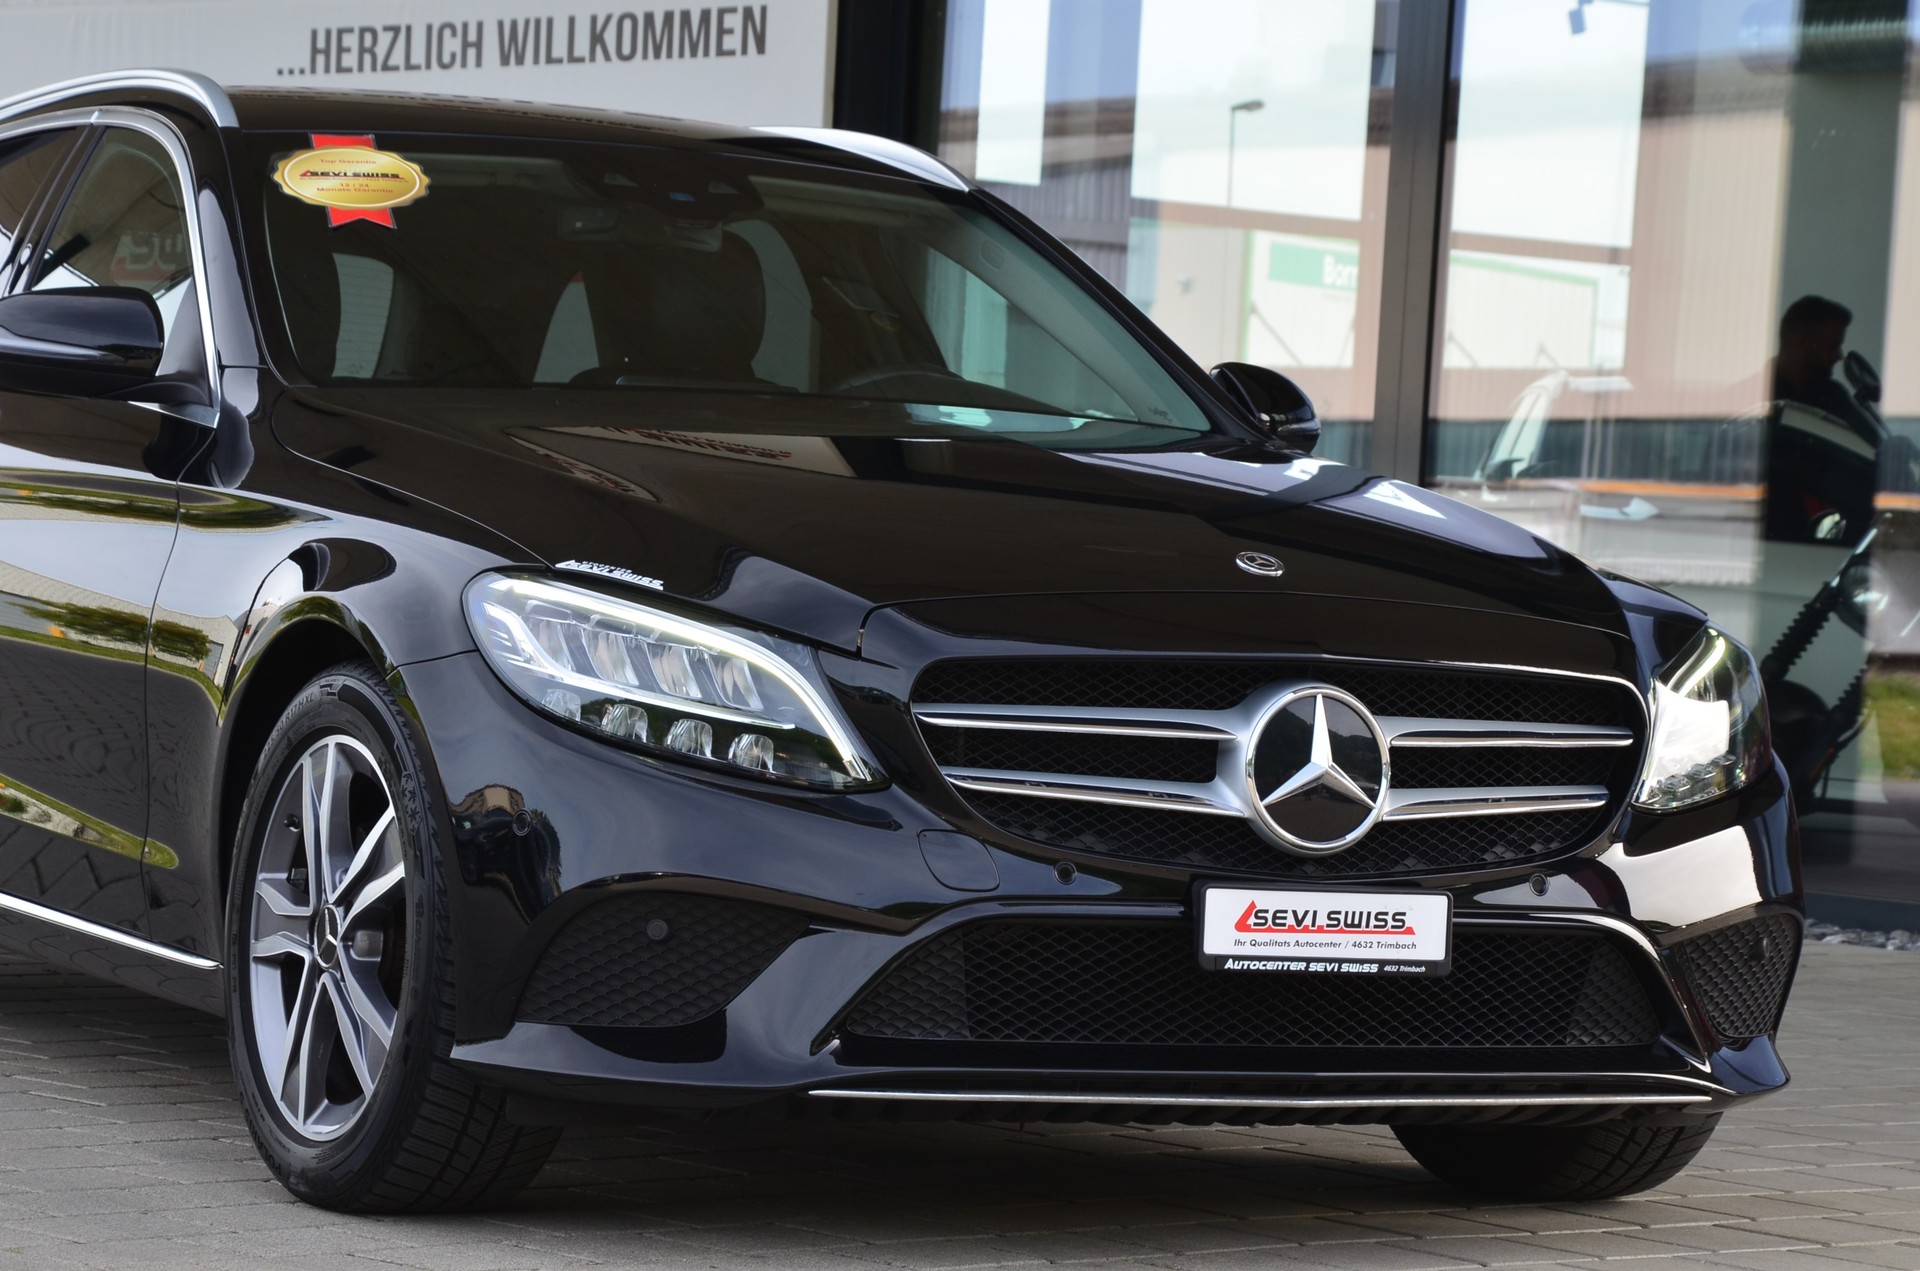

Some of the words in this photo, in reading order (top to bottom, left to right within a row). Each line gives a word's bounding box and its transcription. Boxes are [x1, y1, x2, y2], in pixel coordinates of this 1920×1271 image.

[497, 5, 767, 67] WILLKOMMEN
[612, 570, 664, 588] SWISS
[1252, 909, 1318, 929] SEVI
[1326, 910, 1407, 930] SWISS
[1234, 938, 1247, 947] Ihr
[1249, 939, 1291, 949] Qualitats
[1293, 939, 1342, 949] Autocenter
[1351, 941, 1374, 949] 4632
[1376, 941, 1417, 950] Trimbach
[1308, 961, 1339, 972] SEVI
[1340, 962, 1379, 973] SWISS
[1399, 965, 1426, 973] Trimbach
